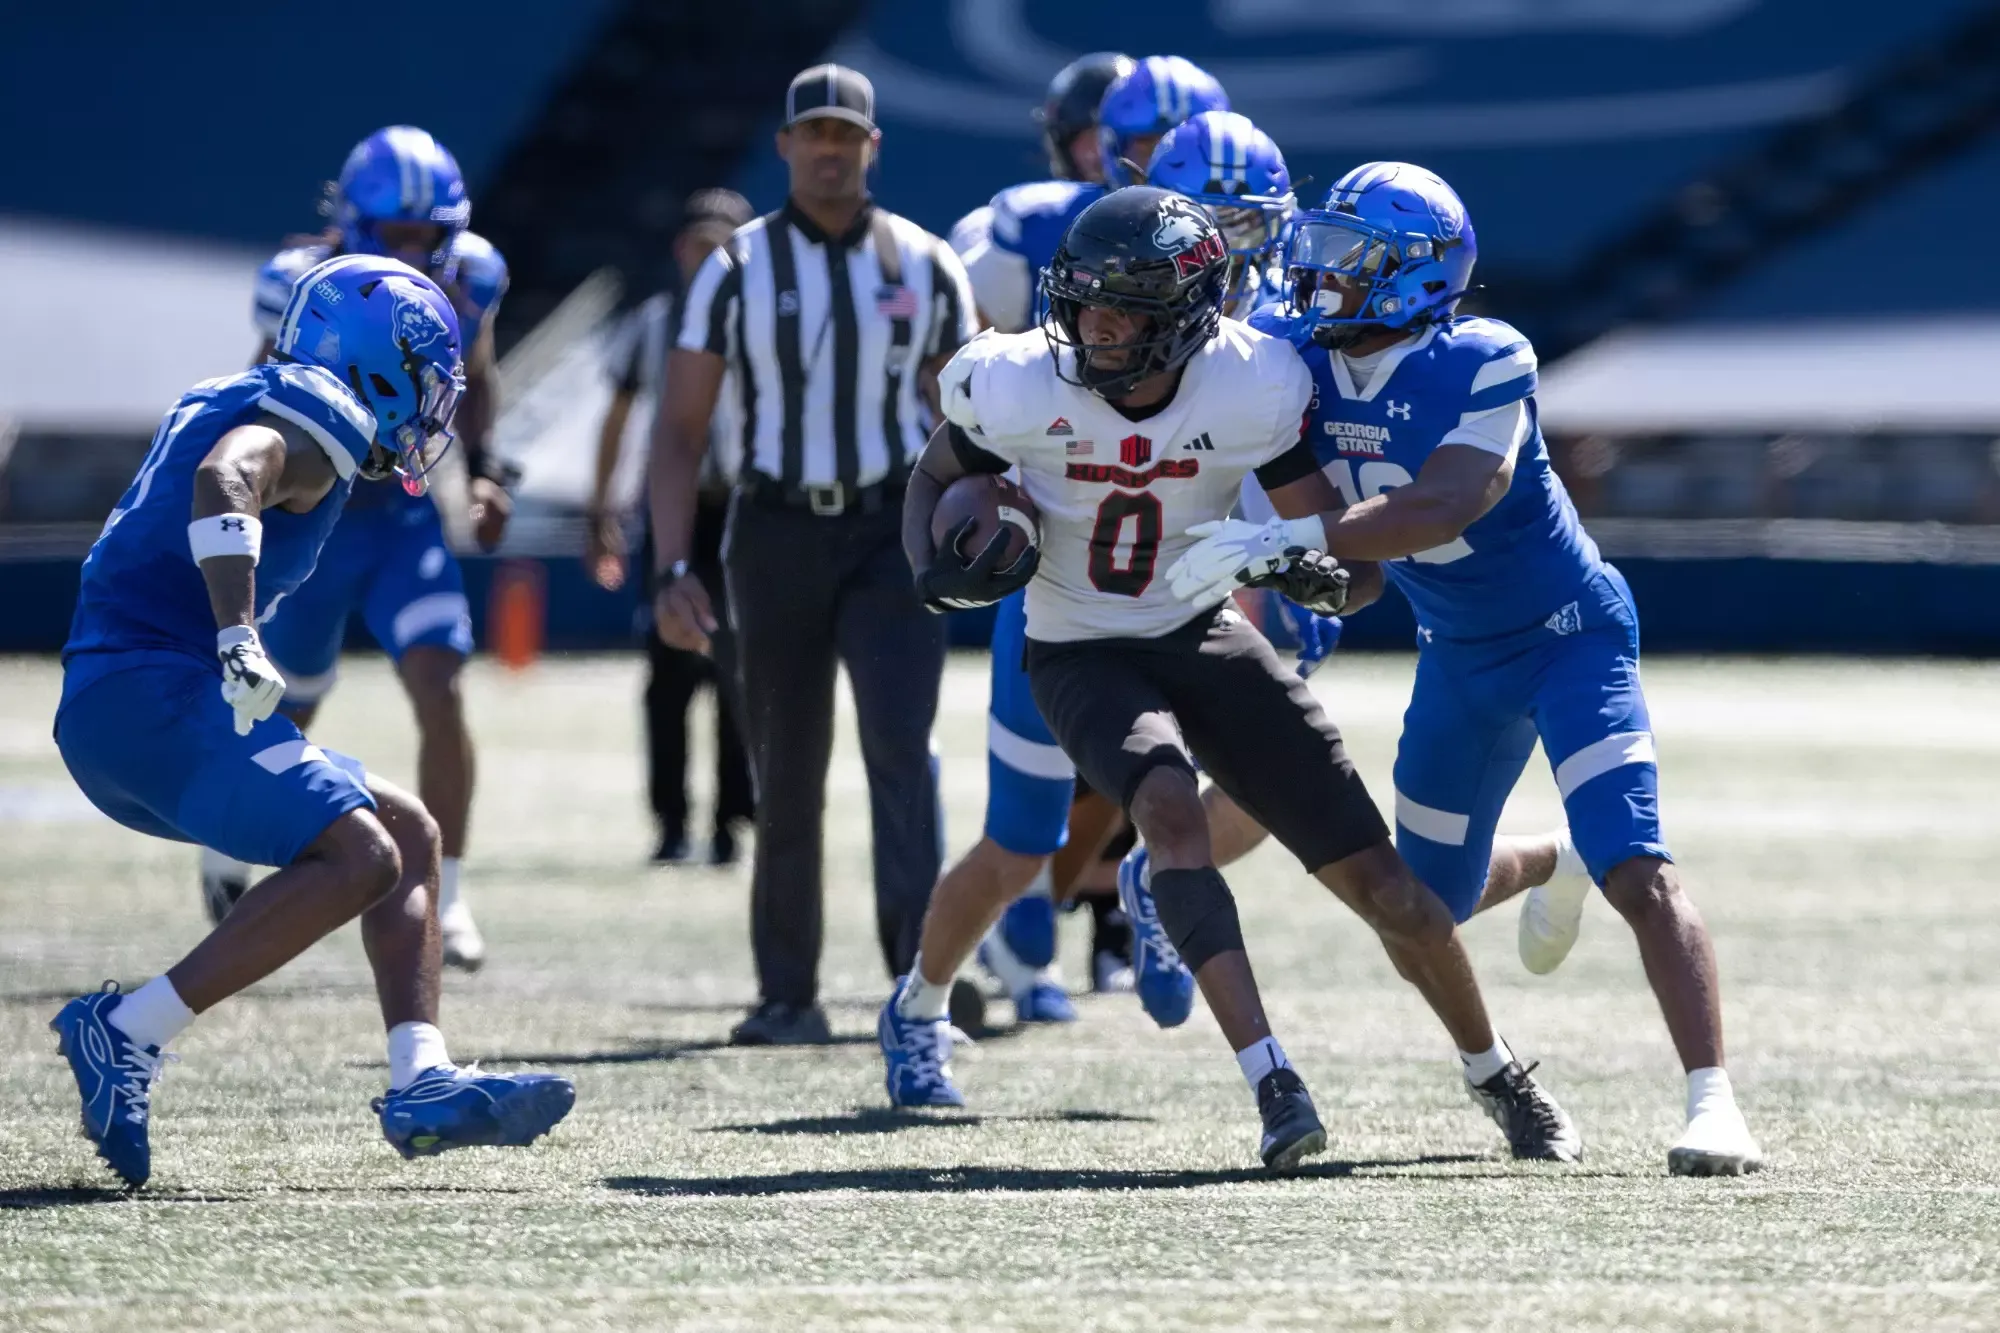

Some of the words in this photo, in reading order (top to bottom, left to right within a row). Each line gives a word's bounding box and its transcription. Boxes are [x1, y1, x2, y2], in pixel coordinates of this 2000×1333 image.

[1323, 421, 1392, 442] GEORGIA
[1336, 437, 1385, 455] STATE
[1064, 457, 1199, 488] HUSKES
[1088, 489, 1163, 599] 0
